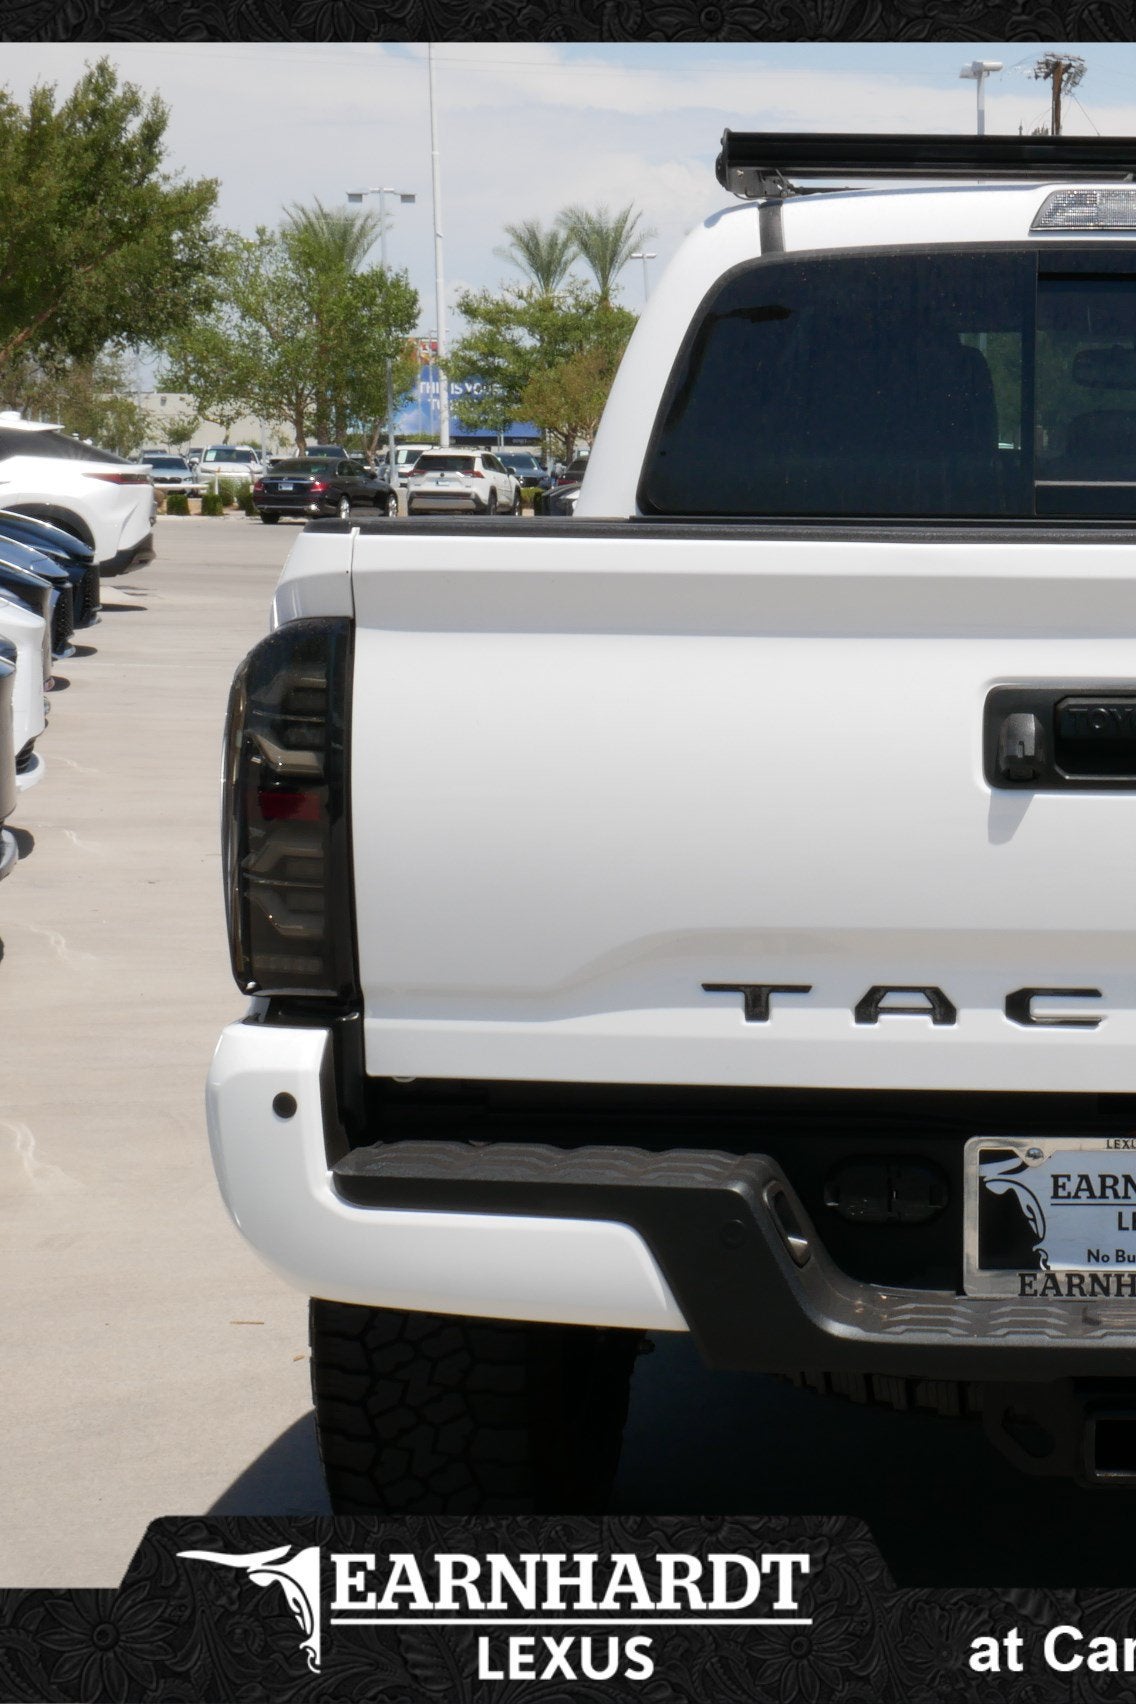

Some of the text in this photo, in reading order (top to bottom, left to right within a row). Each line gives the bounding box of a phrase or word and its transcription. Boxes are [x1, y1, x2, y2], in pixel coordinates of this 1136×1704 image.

[419, 381, 448, 394] THI
[450, 382, 463, 395] IS
[1087, 1249, 1110, 1264] No
